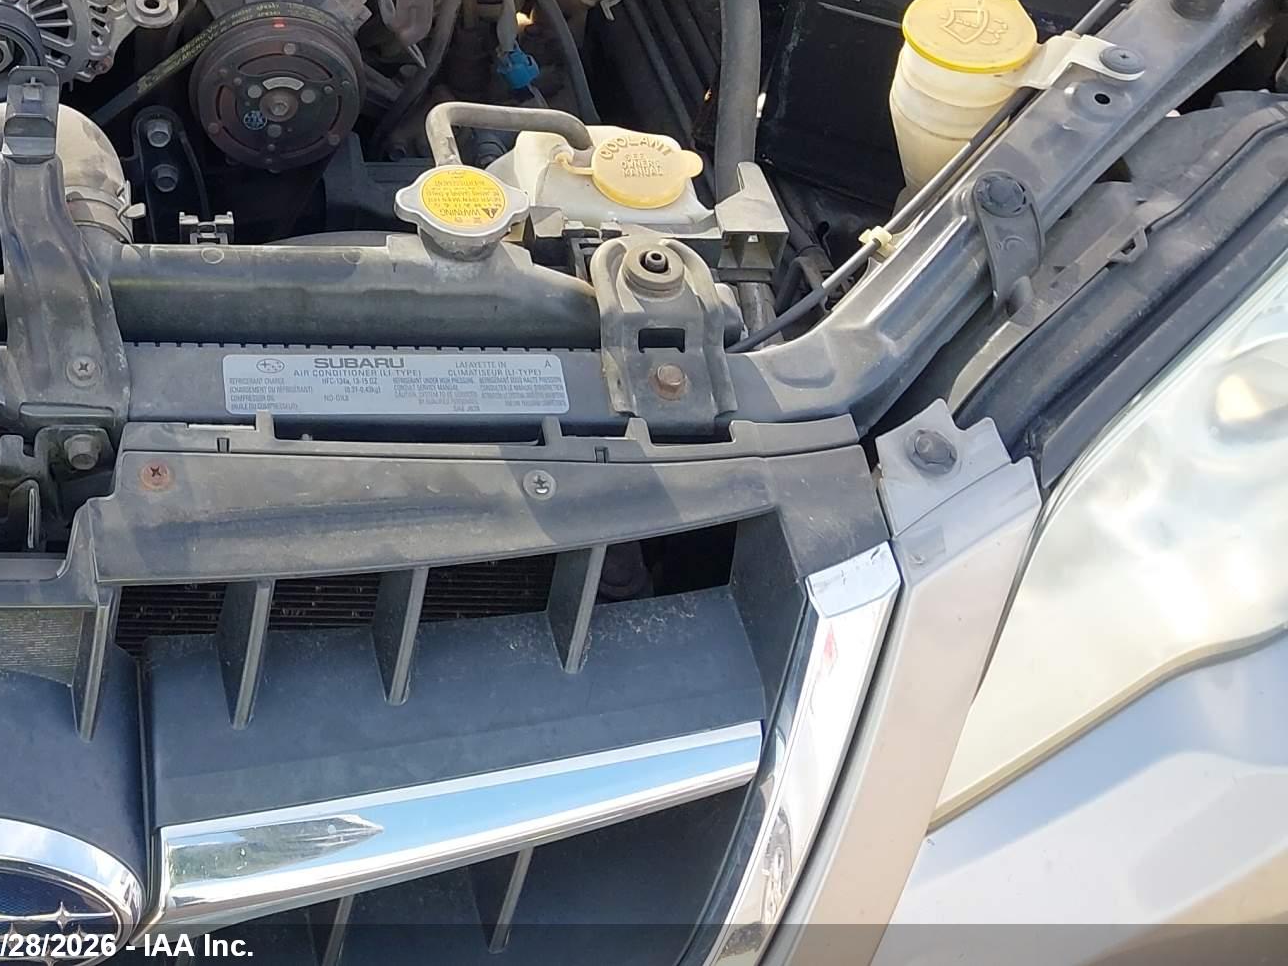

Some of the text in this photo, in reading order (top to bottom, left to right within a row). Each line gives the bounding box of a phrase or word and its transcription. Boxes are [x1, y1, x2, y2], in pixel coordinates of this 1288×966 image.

[600, 137, 673, 160] COOLANT
[439, 208, 481, 217] WARNING
[314, 357, 404, 369] SUBARU
[455, 361, 507, 369] LAFAYETTE IN
[544, 359, 552, 369] A
